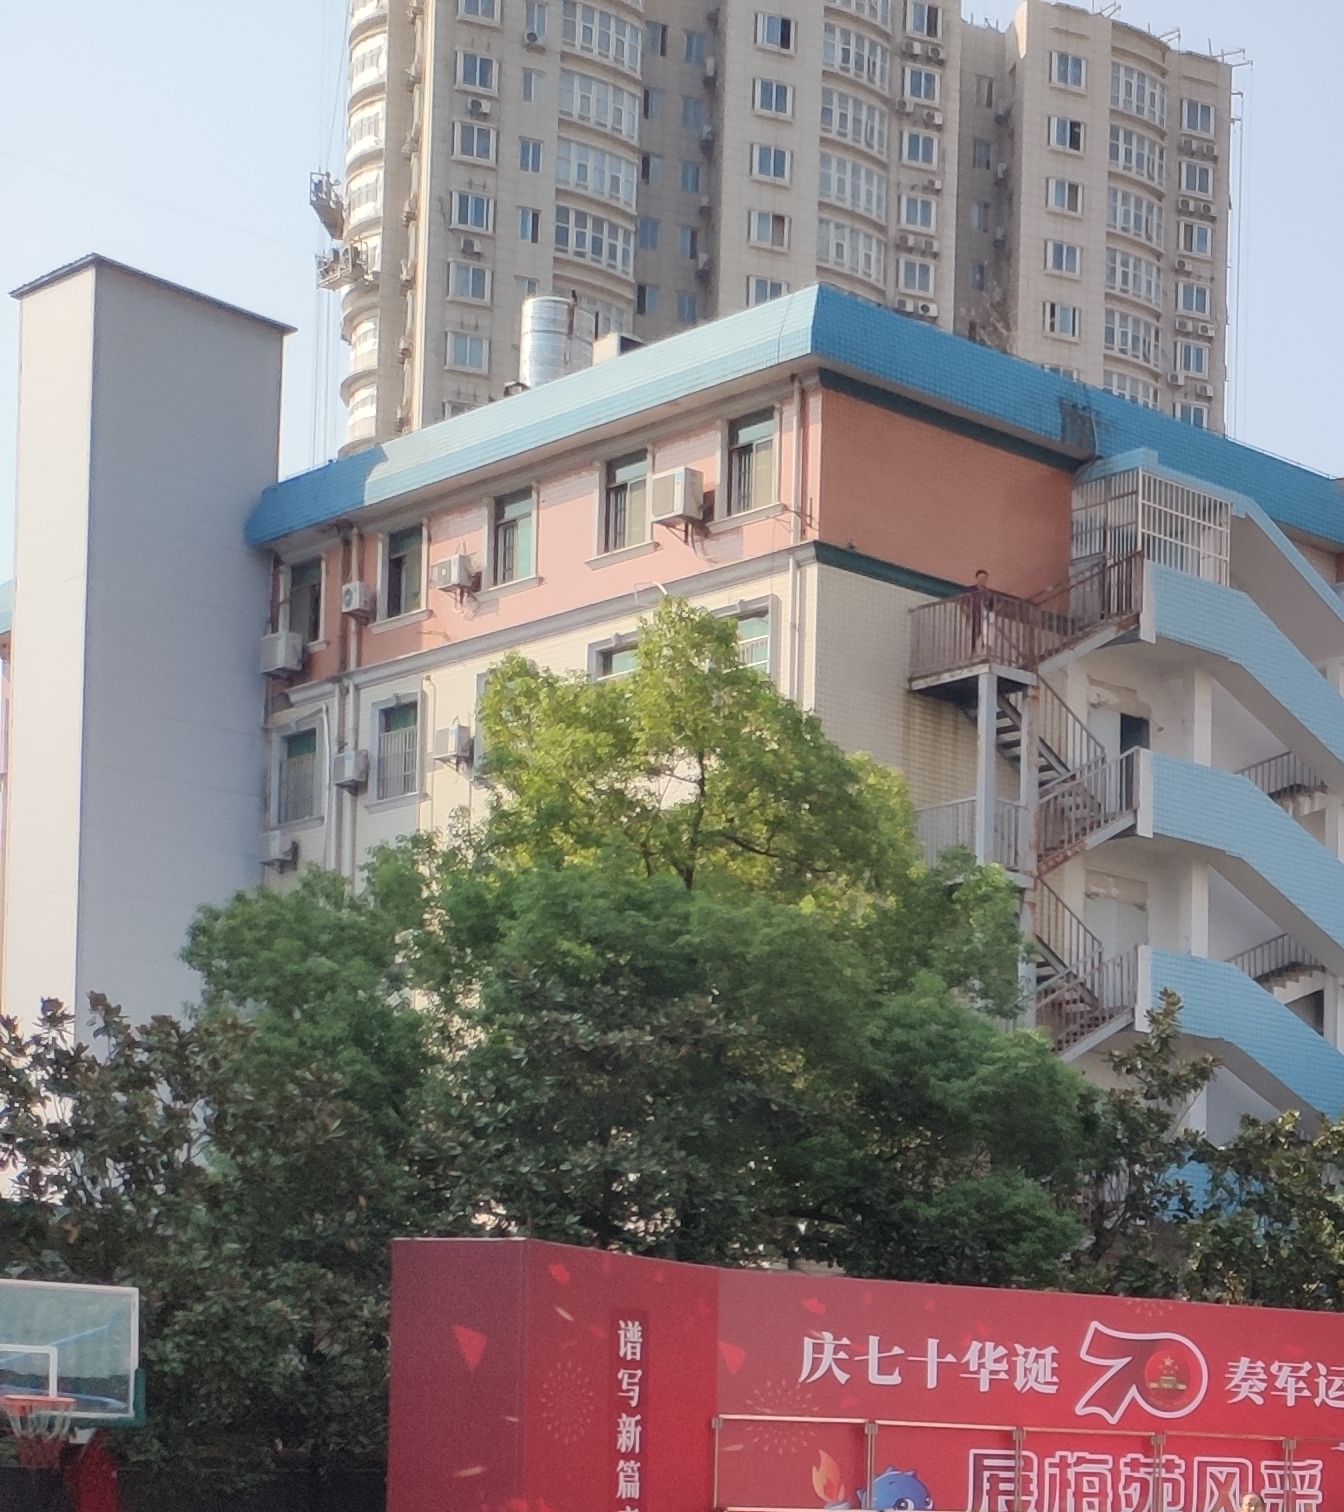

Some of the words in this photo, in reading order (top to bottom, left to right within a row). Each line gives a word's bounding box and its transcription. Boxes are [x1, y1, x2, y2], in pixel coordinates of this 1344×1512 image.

[799, 1332, 1060, 1394] 庆七十华诞
[1075, 1321, 1209, 1424] 70
